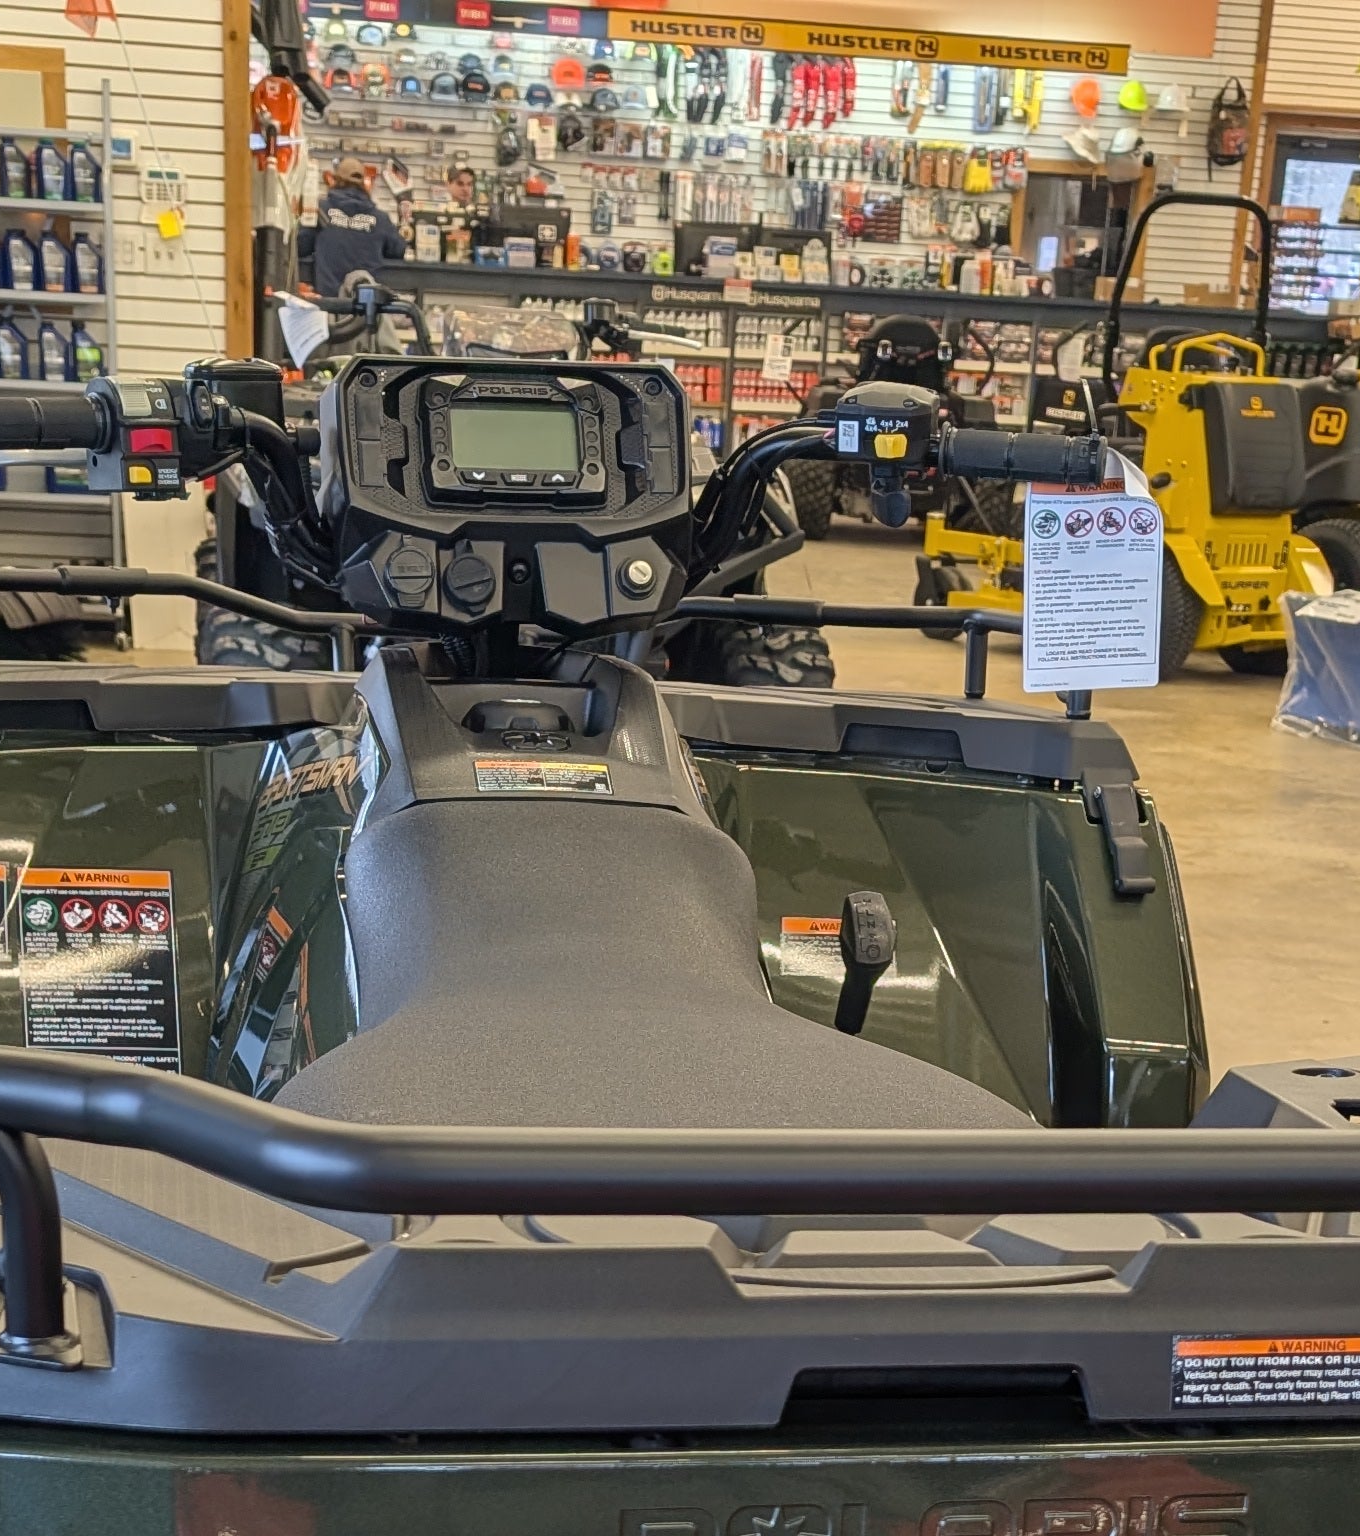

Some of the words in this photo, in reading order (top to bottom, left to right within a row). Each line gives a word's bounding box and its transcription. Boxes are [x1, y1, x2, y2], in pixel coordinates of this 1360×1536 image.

[630, 19, 737, 40] HUSTLER
[808, 31, 911, 52] HUSTLER
[980, 44, 1083, 63] HUSTLER
[478, 386, 549, 396] POLARIS
[75, 873, 130, 883] WARNING
[1281, 1340, 1347, 1353] WARNING
[1185, 1359, 1201, 1367] DO
[1204, 1358, 1228, 1366] NOT
[1230, 1358, 1255, 1366] TOW
[1258, 1357, 1290, 1366] FROM
[1292, 1356, 1322, 1365] RACK
[1325, 1356, 1342, 1364] OR
[1184, 1370, 1217, 1379] Vehicle
[1219, 1370, 1256, 1379] damage
[1303, 1370, 1323, 1378] may
[1325, 1368, 1350, 1376] result
[1183, 1383, 1208, 1392] injury
[1253, 1381, 1273, 1389] Tow
[1275, 1381, 1294, 1390] only
[1296, 1380, 1317, 1389] from
[1203, 1394, 1224, 1402] Rack
[1331, 1391, 1351, 1400] Rear
